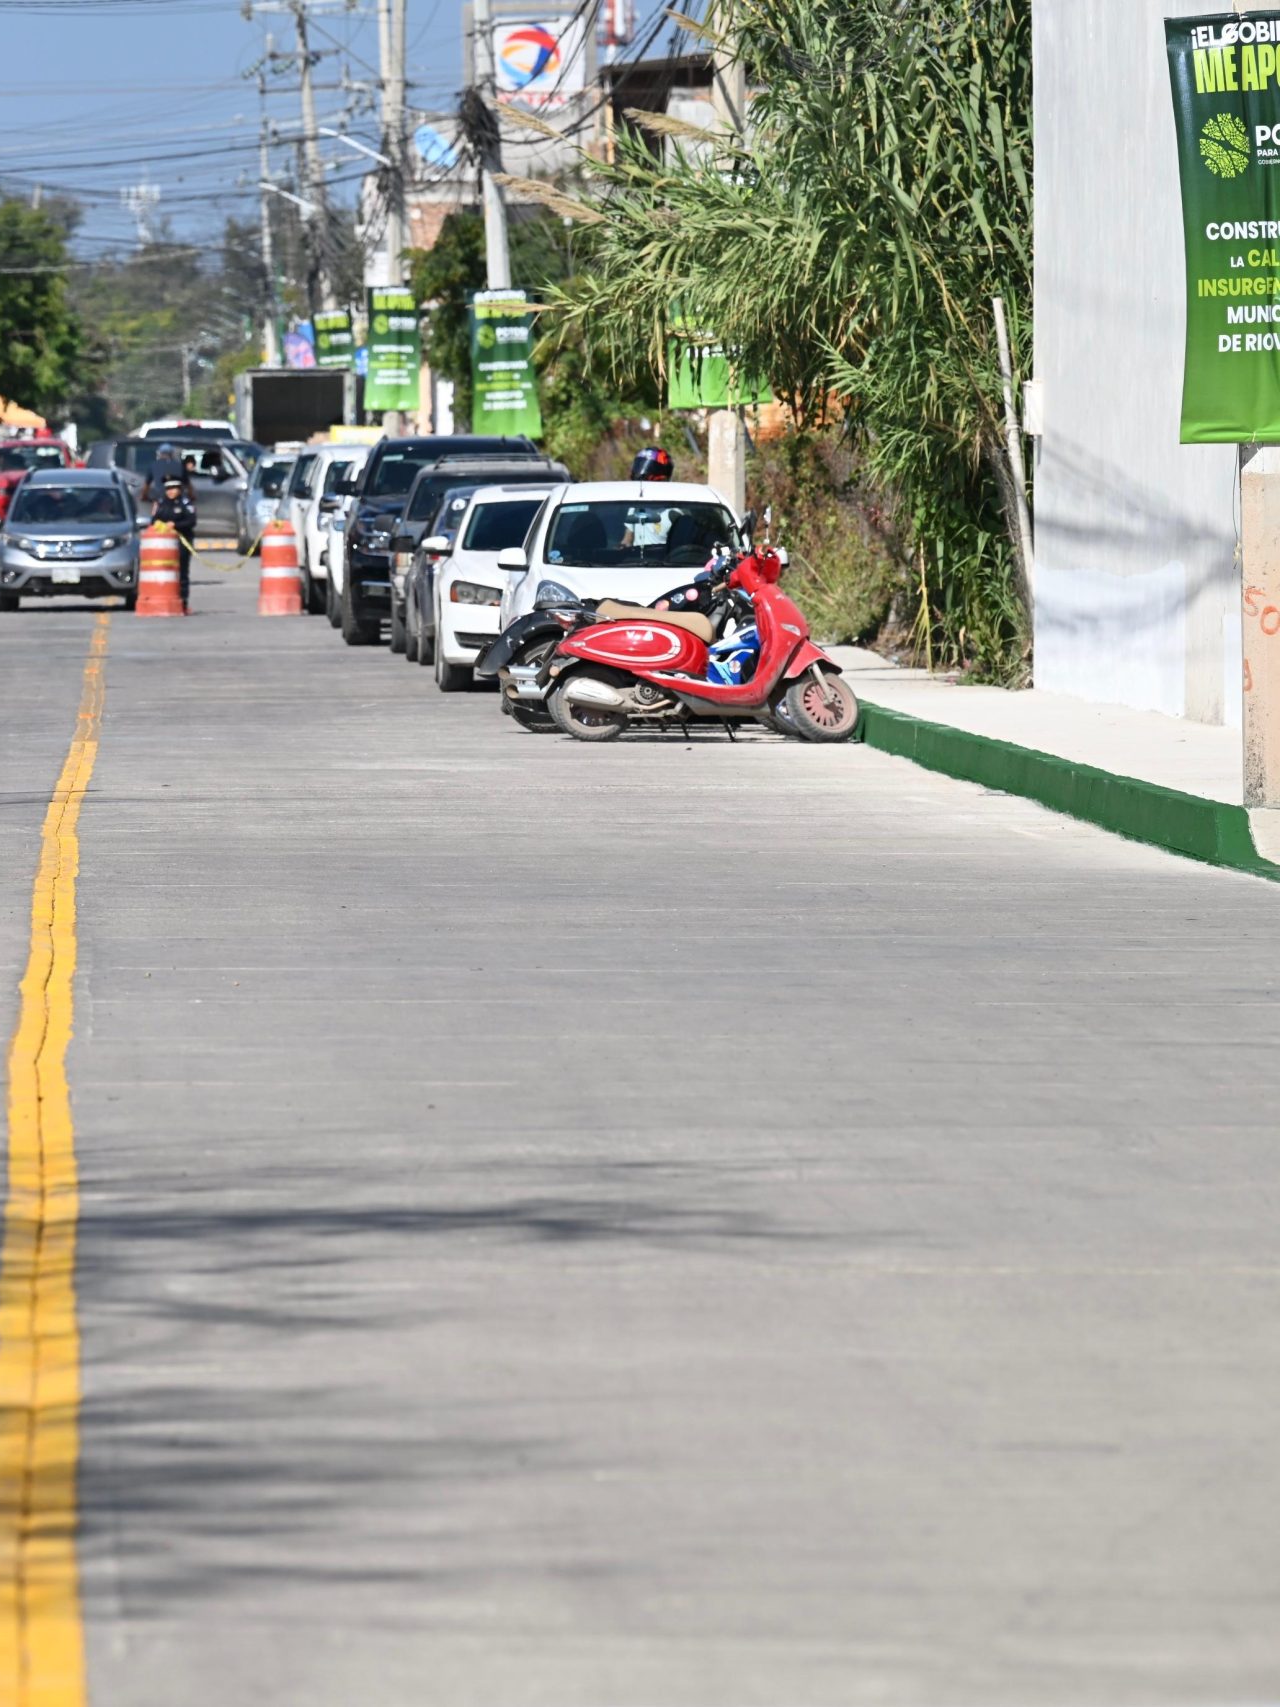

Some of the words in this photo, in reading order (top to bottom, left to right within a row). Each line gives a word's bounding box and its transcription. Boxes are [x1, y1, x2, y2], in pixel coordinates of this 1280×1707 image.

[1193, 46, 1238, 94] ME
[1241, 44, 1280, 92] AP
[1256, 148, 1279, 157] PARA
[1205, 220, 1280, 241] CONSTR
[1230, 256, 1245, 268] LA
[1218, 335, 1242, 353] DE
